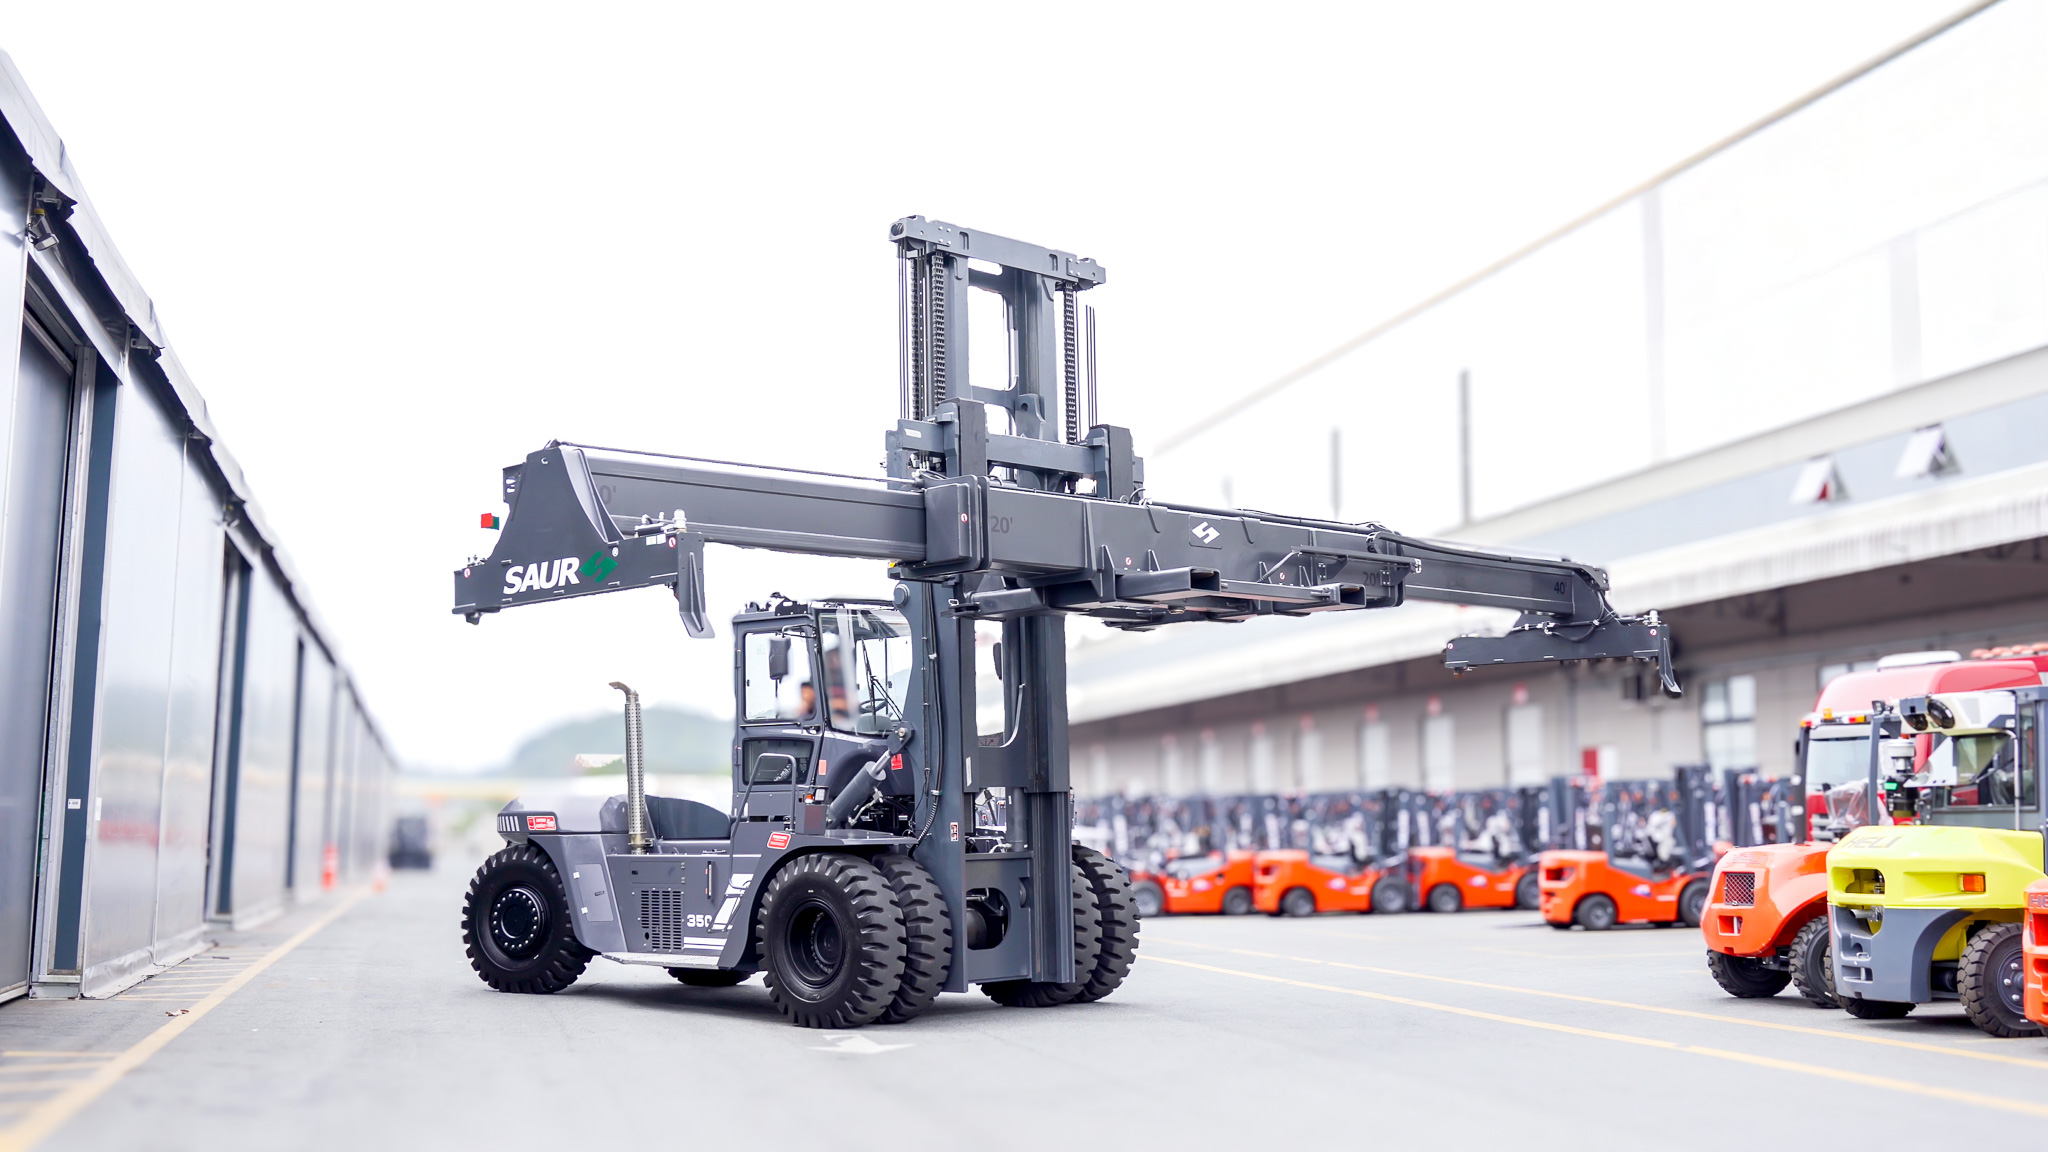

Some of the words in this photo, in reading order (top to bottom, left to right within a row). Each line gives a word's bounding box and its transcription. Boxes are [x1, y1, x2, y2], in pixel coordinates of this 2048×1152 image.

[990, 515, 1013, 534] 20'
[503, 557, 580, 595] SAUR
[1553, 581, 1568, 595] 40'
[1841, 836, 1903, 849] HELI
